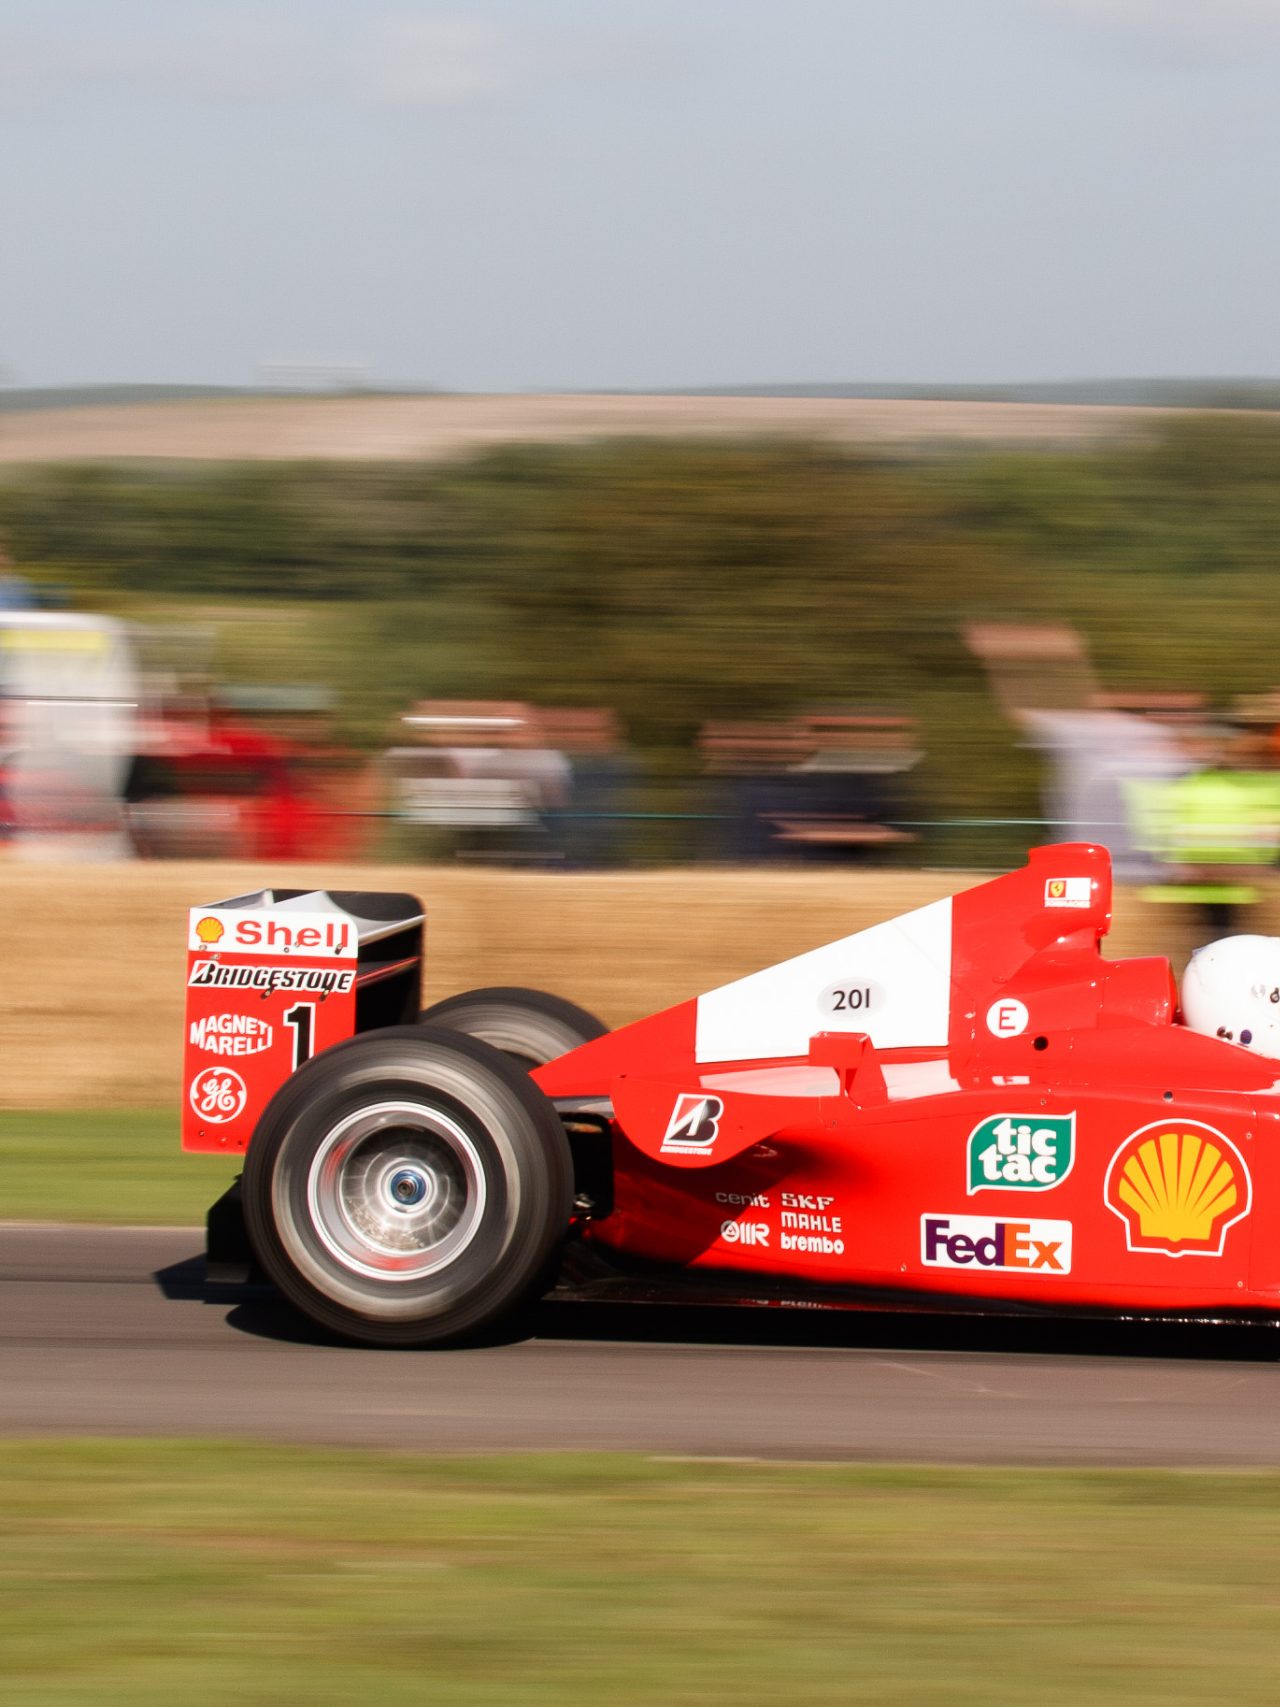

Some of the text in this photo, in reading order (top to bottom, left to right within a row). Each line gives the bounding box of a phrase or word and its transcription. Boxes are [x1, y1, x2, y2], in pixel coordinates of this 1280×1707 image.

[235, 919, 349, 948] Shell
[833, 988, 870, 1011] 201
[999, 1007, 1017, 1030] E
[284, 1002, 316, 1073] 1
[992, 1118, 1057, 1155] tic
[978, 1144, 1057, 1183] tac
[781, 1193, 835, 1210] SKF
[780, 1211, 842, 1233] MAHLE
[780, 1232, 845, 1255] brembo
[925, 1219, 1064, 1270] FedEx
